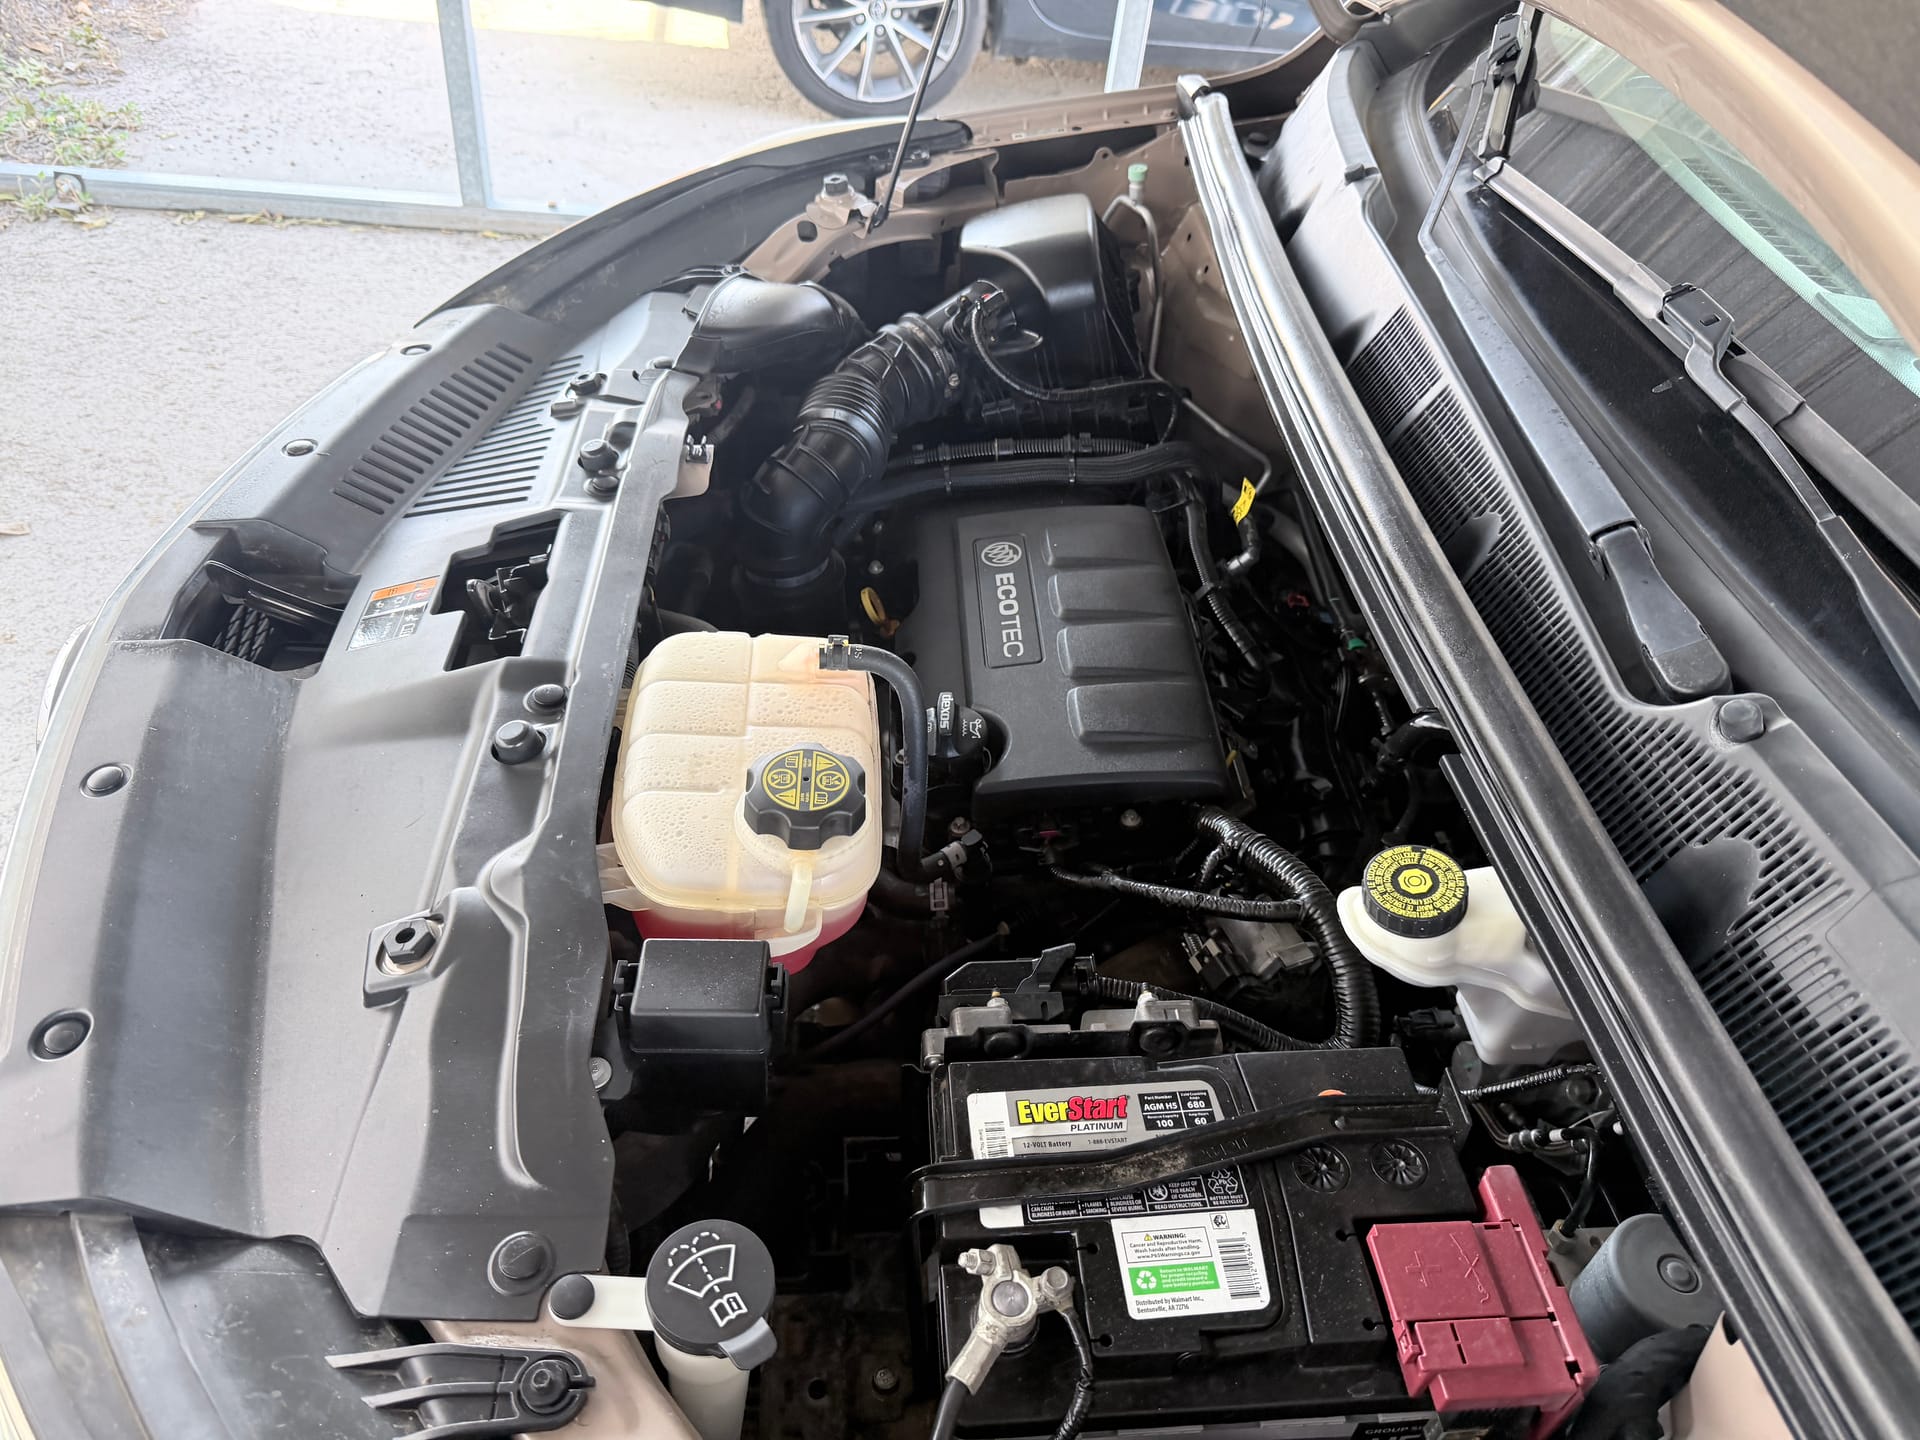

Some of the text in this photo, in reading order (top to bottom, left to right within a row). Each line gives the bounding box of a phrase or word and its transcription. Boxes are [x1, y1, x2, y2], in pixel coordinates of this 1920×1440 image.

[995, 572, 1024, 658] ECOTEC
[940, 694, 954, 730] dexos
[1144, 1102, 1178, 1111] AGM H5
[1187, 1100, 1206, 1109] 680
[1016, 1094, 1128, 1125] EverStart
[1156, 1119, 1174, 1128] 100
[1194, 1117, 1207, 1125] 60
[1070, 1121, 1123, 1132] PLATINUM
[1023, 1139, 1072, 1149] 12-VOLT Battery
[1153, 1232, 1186, 1240] WARNING:
[1156, 1239, 1188, 1247] Reproductive
[1135, 1298, 1163, 1306] Distributed
[1170, 1295, 1192, 1303] Walmart
[1137, 1305, 1168, 1313] Bentonville,
[1364, 1426, 1409, 1435] GROUP
